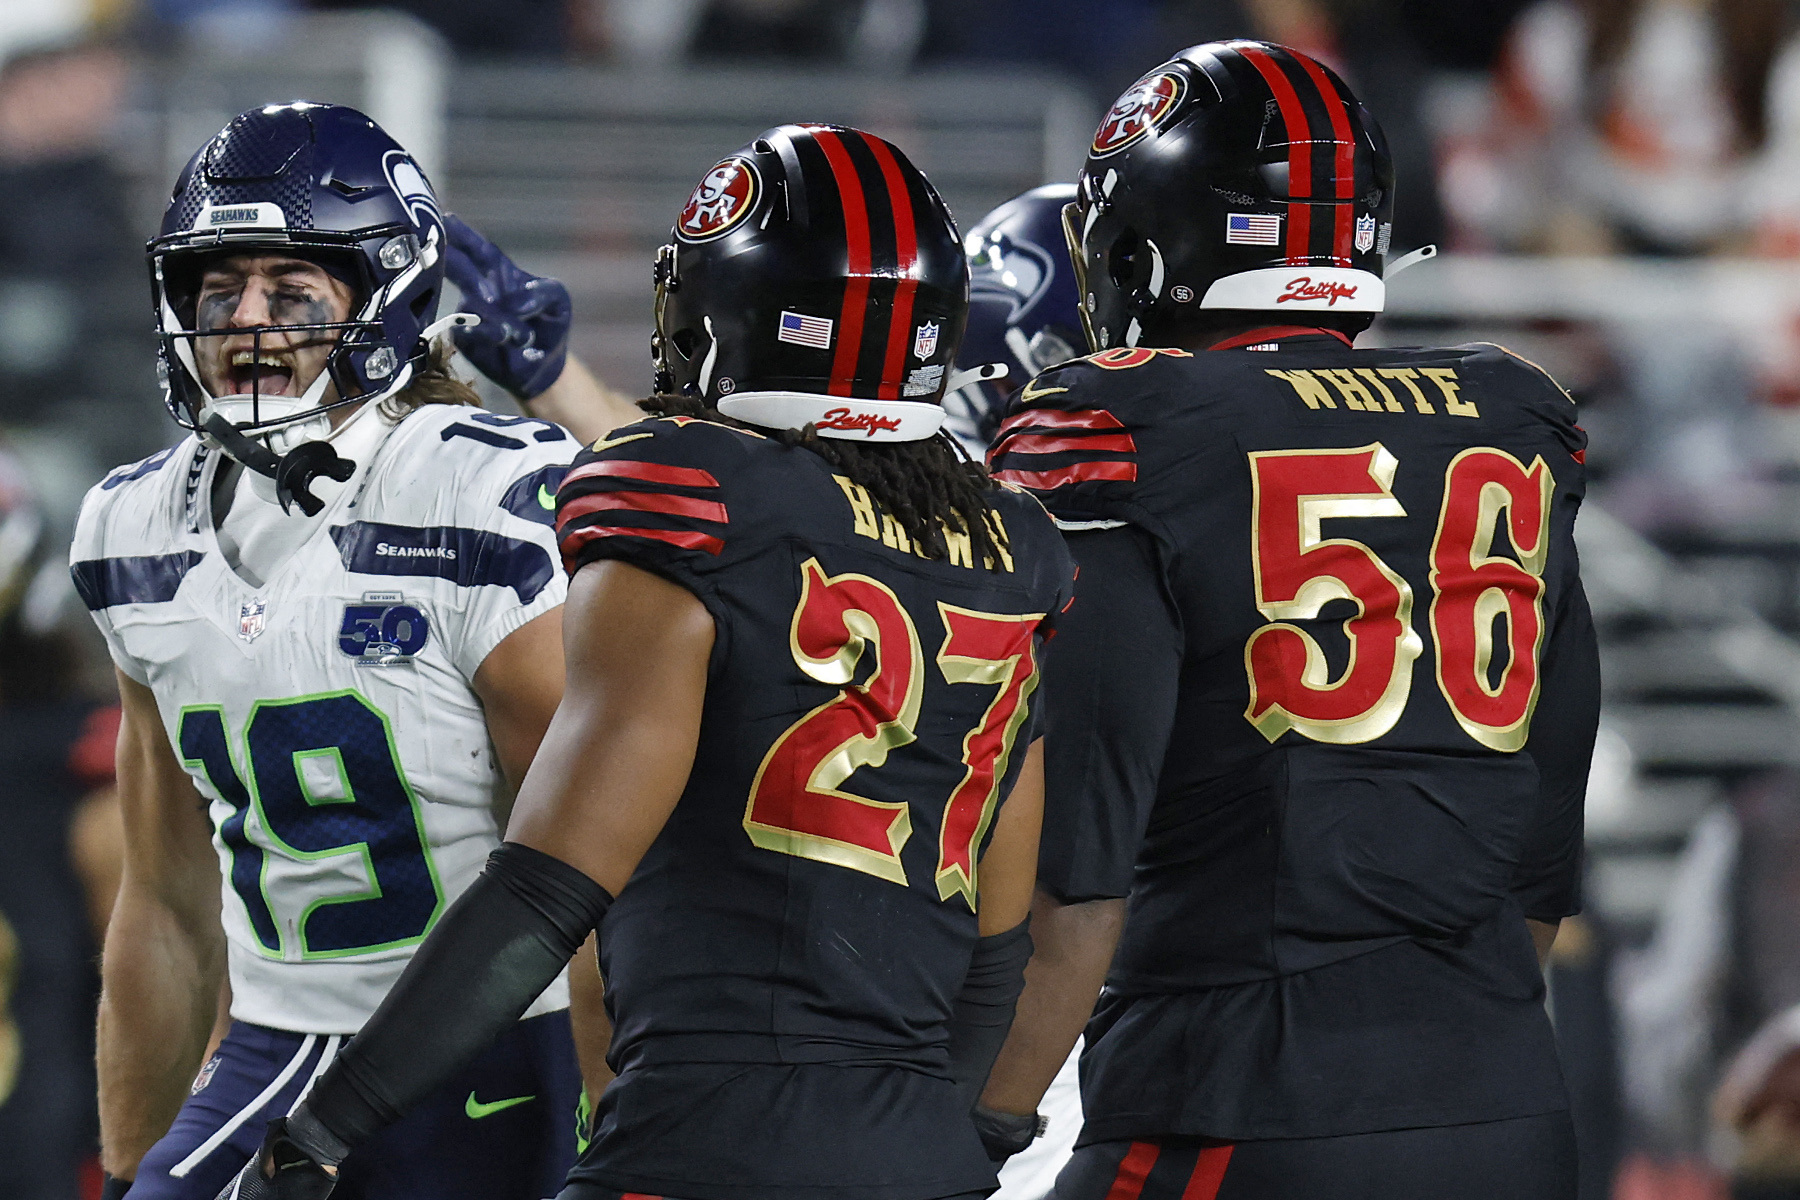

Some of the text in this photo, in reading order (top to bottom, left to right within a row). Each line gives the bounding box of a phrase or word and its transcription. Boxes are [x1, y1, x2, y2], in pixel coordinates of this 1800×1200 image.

[209, 207, 259, 224] SEAHAWKS
[1176, 288, 1188, 300] 56
[1277, 276, 1358, 306] Faithful
[721, 379, 731, 392] 27
[1265, 367, 1480, 418] WHITE
[375, 542, 457, 560] SEAHAWKS
[1243, 441, 1556, 753] 56
[338, 605, 428, 656] 50
[742, 556, 1047, 914] 27
[177, 688, 446, 960] 19
